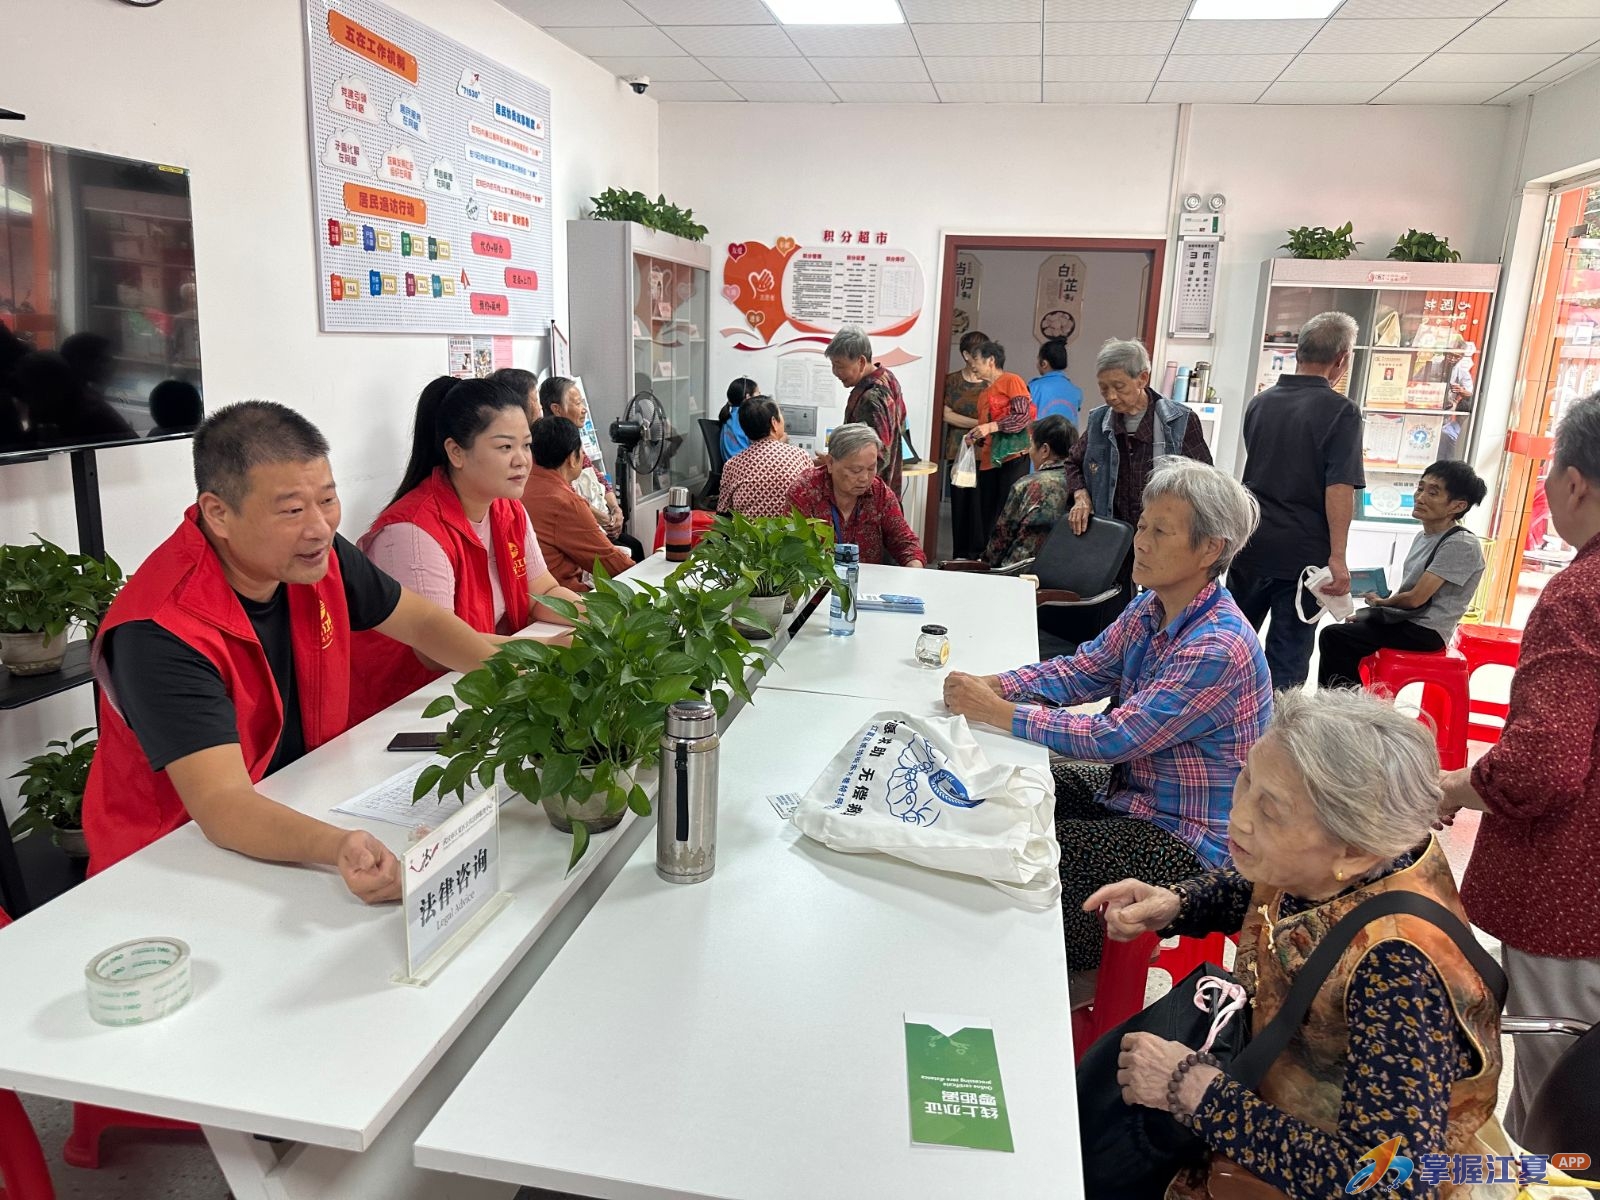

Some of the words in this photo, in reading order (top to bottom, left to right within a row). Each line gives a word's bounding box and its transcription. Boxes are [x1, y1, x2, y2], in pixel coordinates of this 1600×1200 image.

[823, 230, 888, 244] 积分超市
[419, 848, 488, 928] 法律咨询
[436, 907, 455, 931] Legal
[454, 890, 476, 914] Advice
[941, 1090, 997, 1106] 零距离
[924, 1101, 999, 1119] 线上办证
